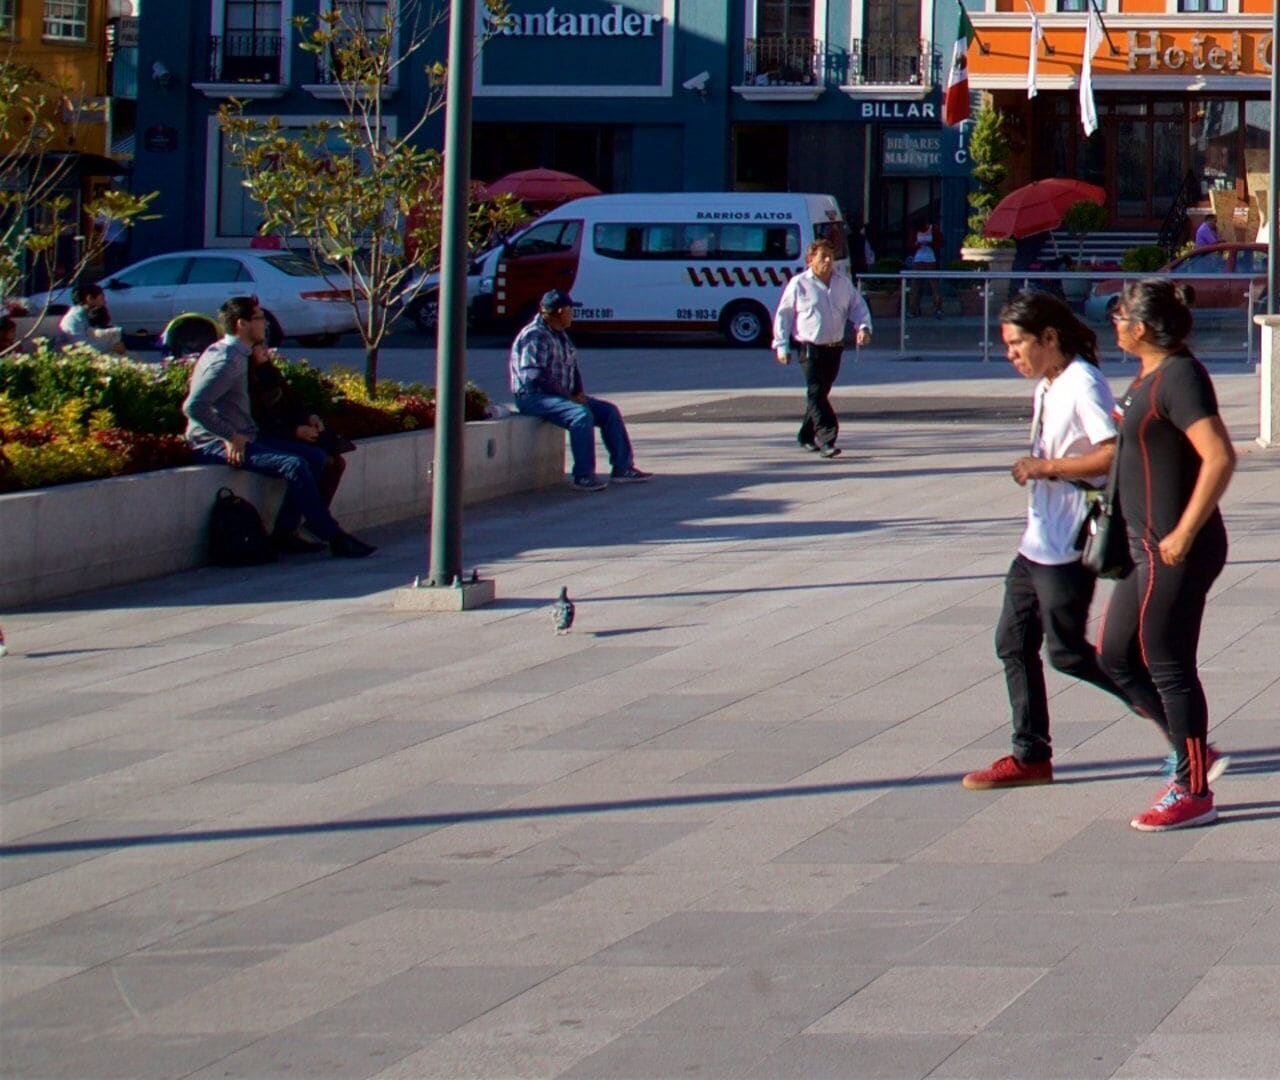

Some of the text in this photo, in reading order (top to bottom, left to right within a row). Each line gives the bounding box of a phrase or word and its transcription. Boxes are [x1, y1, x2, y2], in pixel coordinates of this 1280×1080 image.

[482, 4, 662, 37] Santander
[1127, 29, 1240, 70] Hotel
[861, 102, 935, 118] BILLAR
[887, 137, 940, 150] BILLARES
[696, 211, 793, 221] BARRIOS ALTOS
